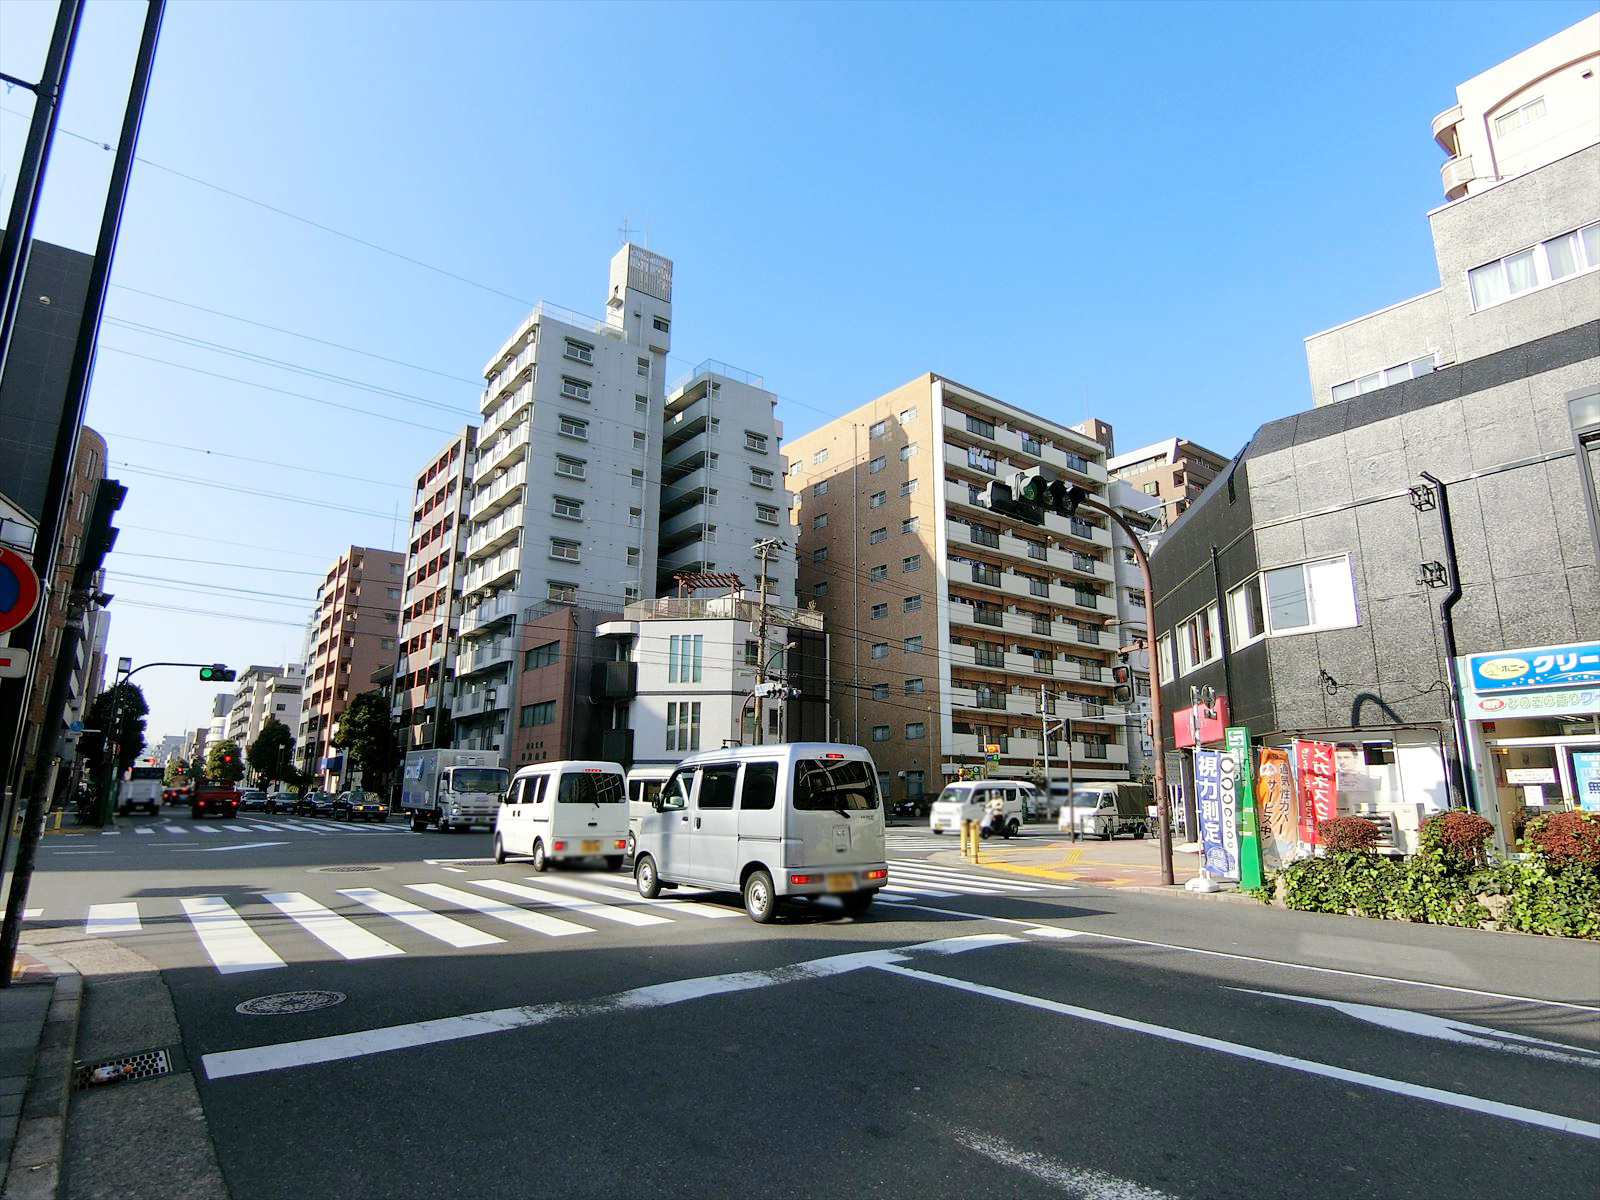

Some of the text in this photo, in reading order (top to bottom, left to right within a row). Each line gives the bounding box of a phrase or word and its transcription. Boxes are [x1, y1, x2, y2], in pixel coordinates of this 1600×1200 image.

[1533, 653, 1599, 674] クリー
[405, 765, 420, 779] CNG
[1198, 756, 1222, 845] 視力測定
[1277, 763, 1291, 835] 通気性カバー
[1260, 779, 1278, 841] サービス中!
